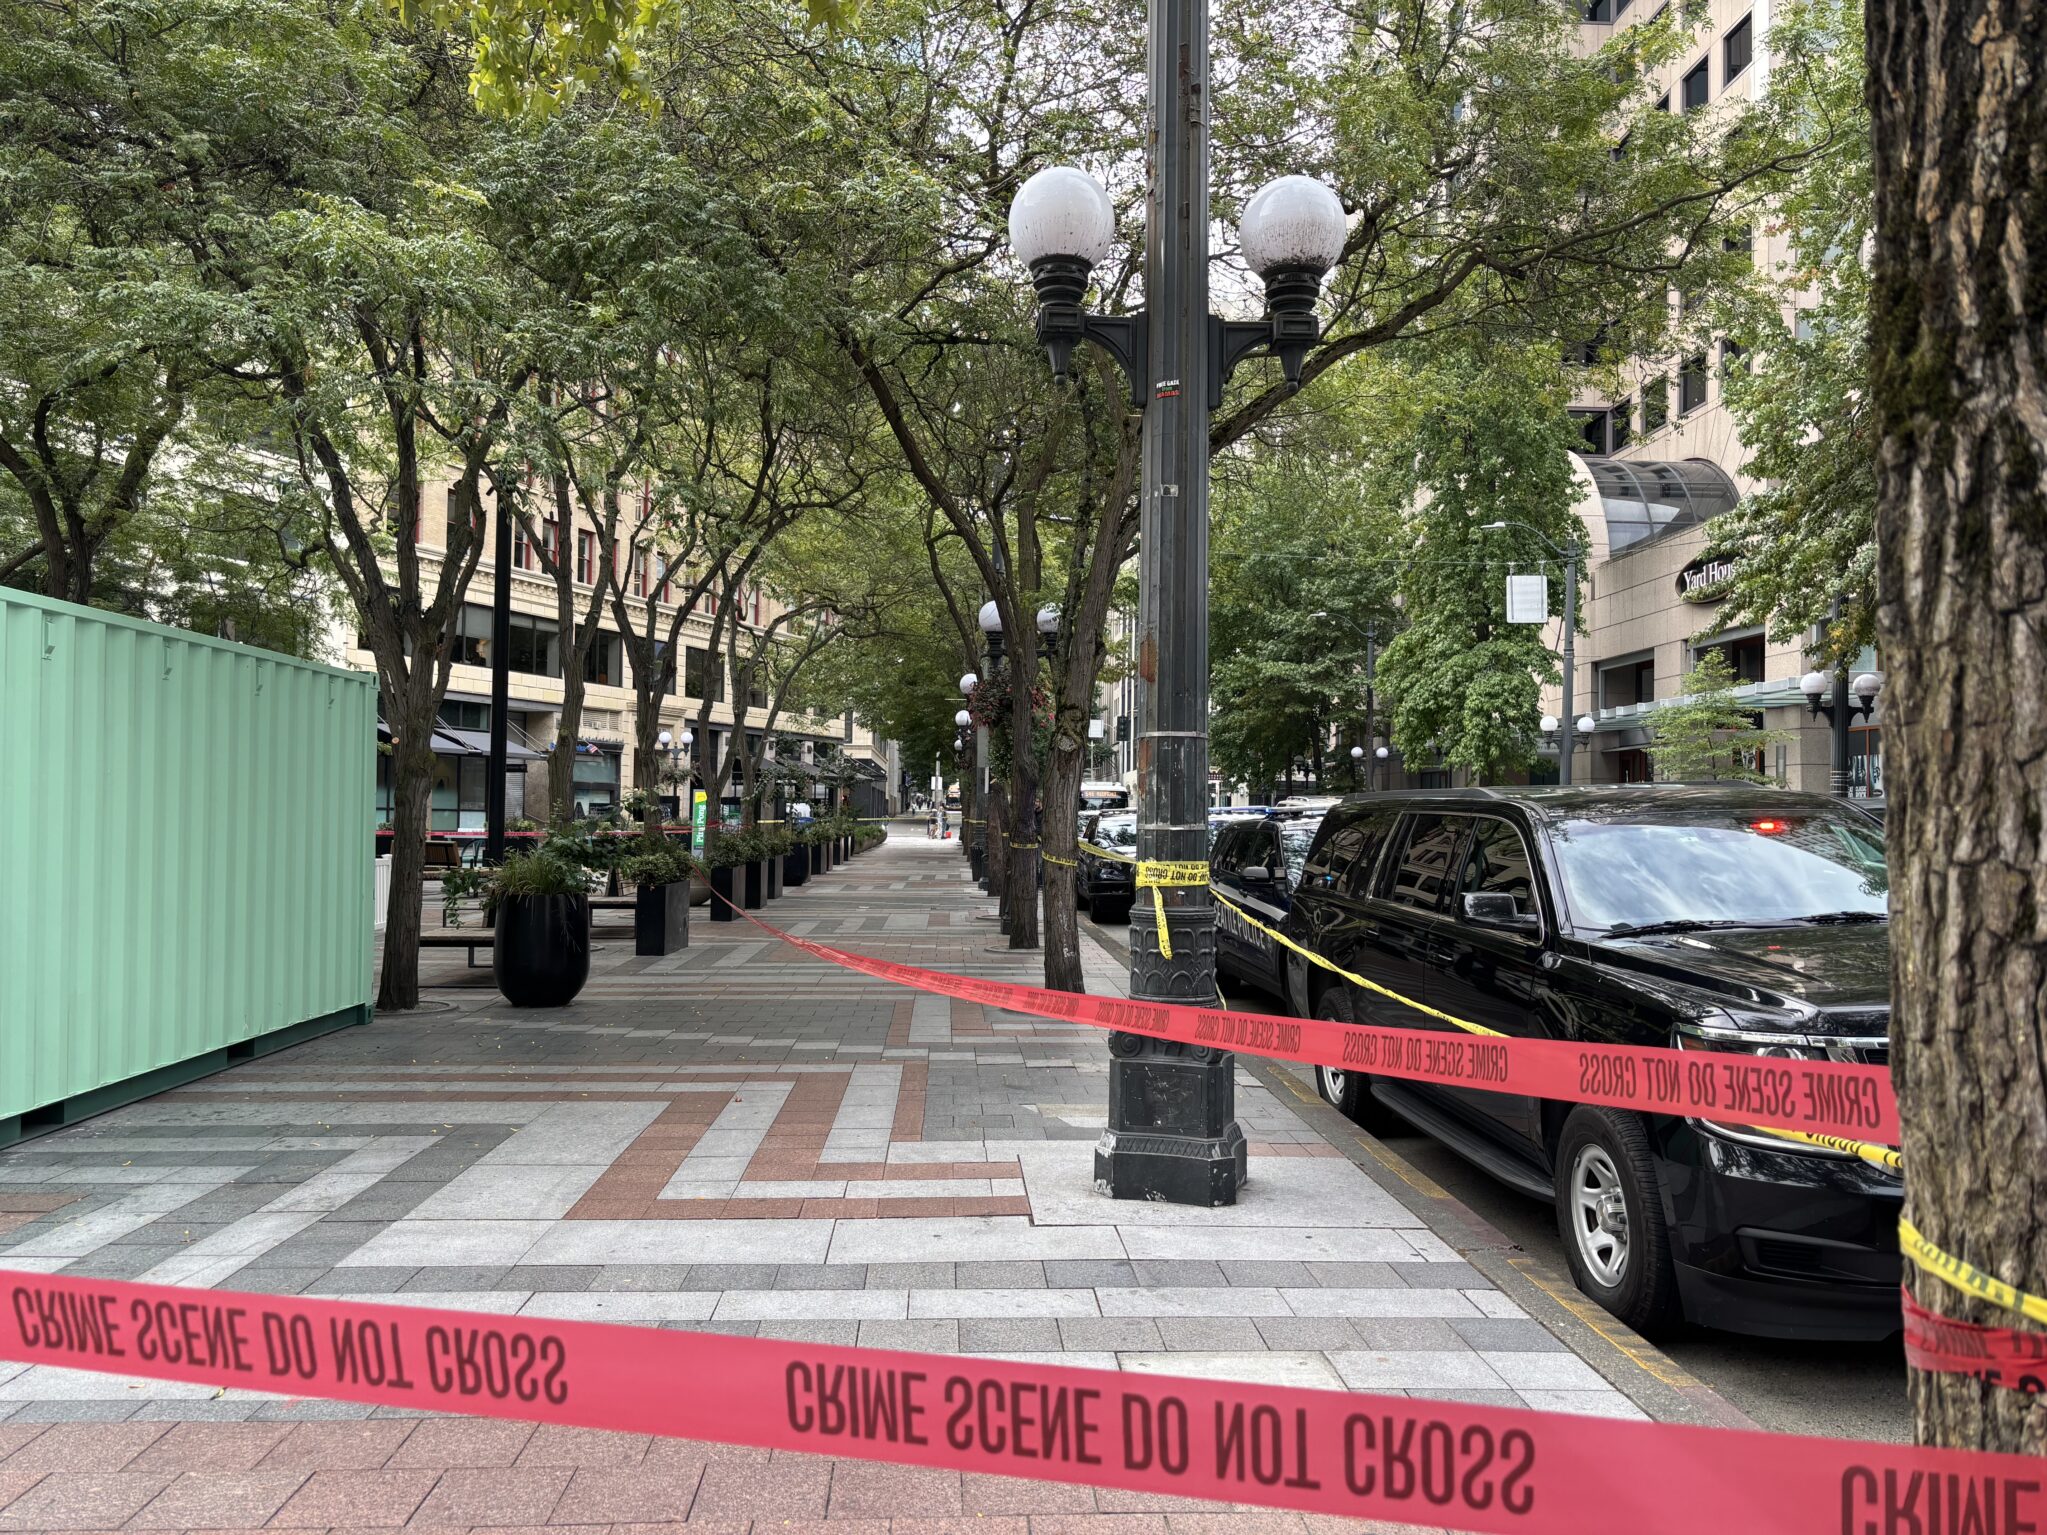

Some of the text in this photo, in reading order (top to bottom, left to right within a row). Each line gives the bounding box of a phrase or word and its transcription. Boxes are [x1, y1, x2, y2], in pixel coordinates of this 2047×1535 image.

[1683, 561, 1735, 591] Yard Hou
[1170, 870, 1185, 881] NOT
[1213, 899, 1238, 935] SEATTLE
[1237, 911, 1266, 950] POLICE
